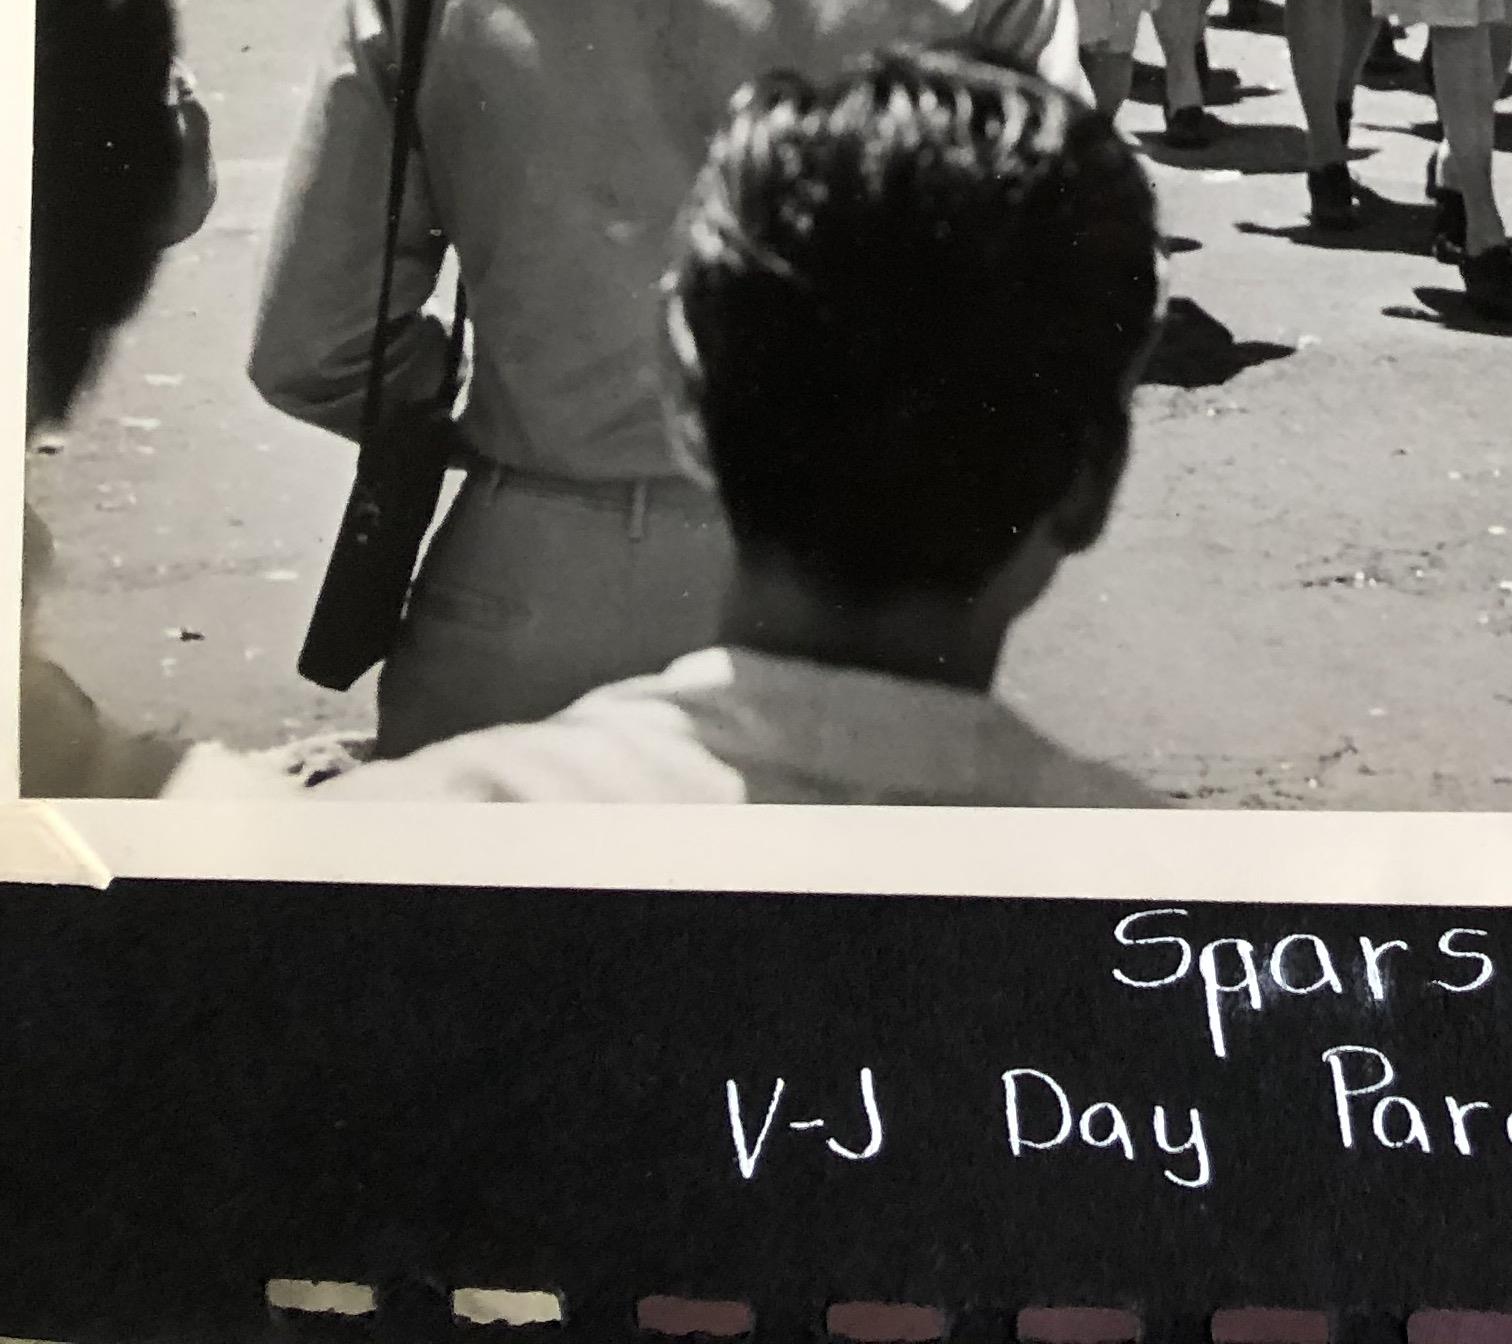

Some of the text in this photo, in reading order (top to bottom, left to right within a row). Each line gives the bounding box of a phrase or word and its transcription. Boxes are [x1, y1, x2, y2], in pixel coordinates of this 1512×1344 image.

[1111, 908, 1494, 1057] Spars
[726, 1067, 883, 1179] V-J
[1002, 1066, 1212, 1188] Day
